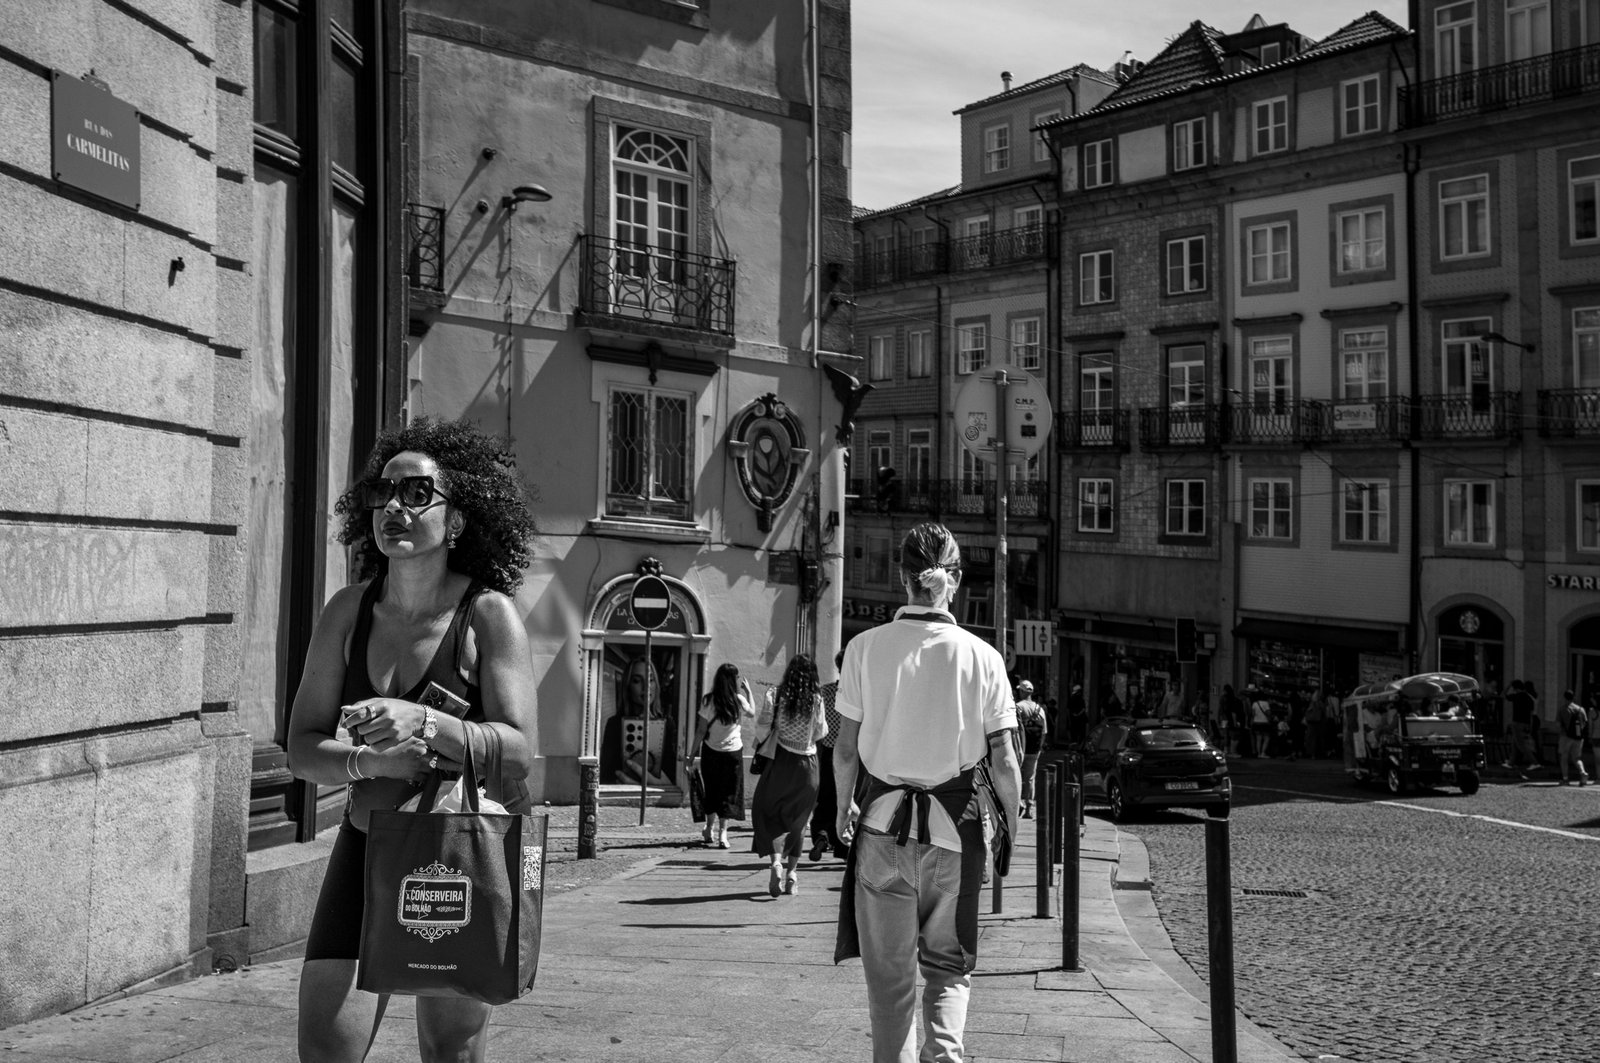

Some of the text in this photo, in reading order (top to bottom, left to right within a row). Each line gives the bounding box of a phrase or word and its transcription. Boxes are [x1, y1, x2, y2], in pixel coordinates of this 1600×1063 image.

[67, 133, 130, 173] CARMELITAS
[411, 889, 464, 902] CONSERVEIRA
[411, 903, 432, 913] BOLHÃO
[438, 963, 458, 971] BOLHÃO
